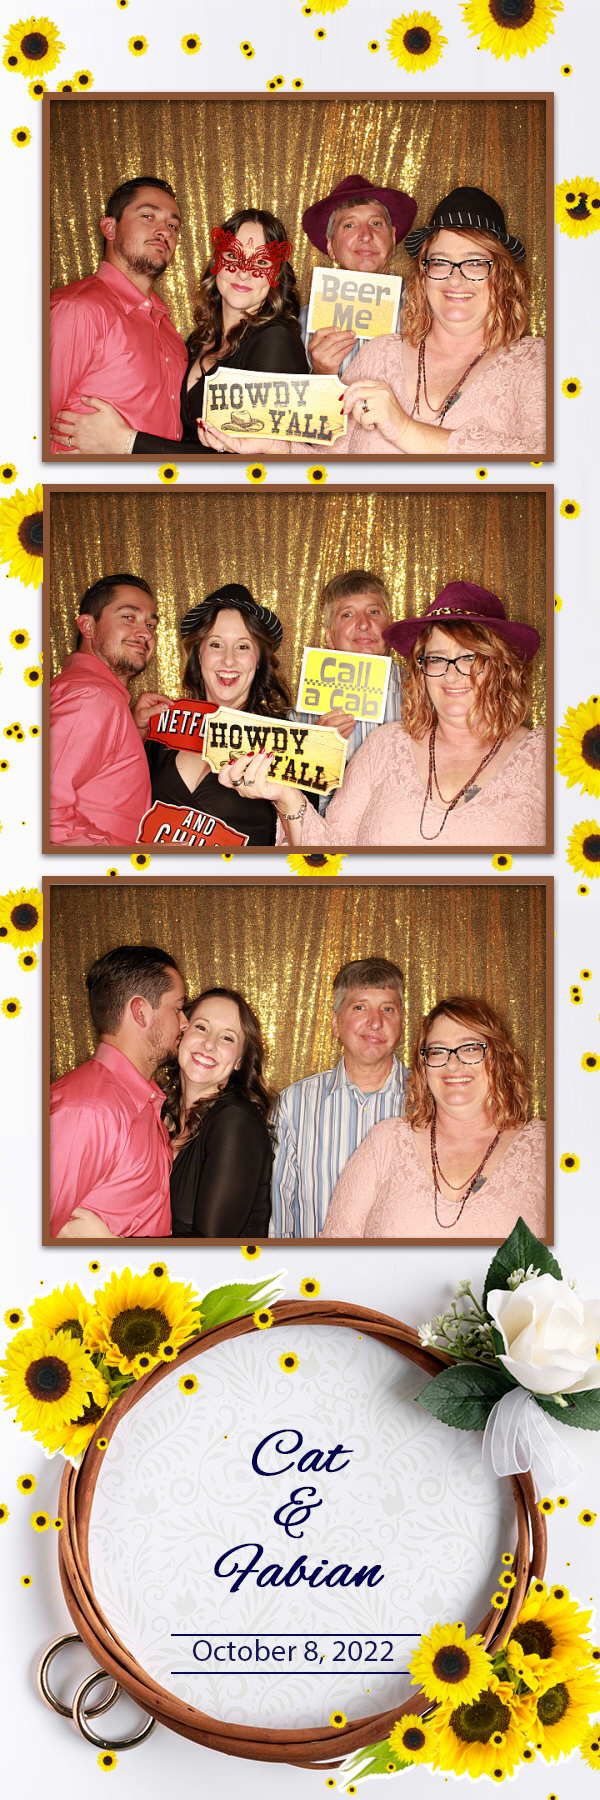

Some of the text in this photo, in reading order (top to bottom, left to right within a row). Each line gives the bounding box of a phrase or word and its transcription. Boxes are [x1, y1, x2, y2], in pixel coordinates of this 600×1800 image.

[322, 274, 391, 306] Beer
[333, 302, 373, 330] Me
[208, 380, 310, 411] HOWDY
[269, 409, 333, 440] Y'ALL
[320, 657, 372, 688] Call
[304, 687, 321, 706] a
[209, 722, 308, 754] HOWDY
[268, 756, 328, 791] Y'ALL
[181, 810, 216, 836] AND
